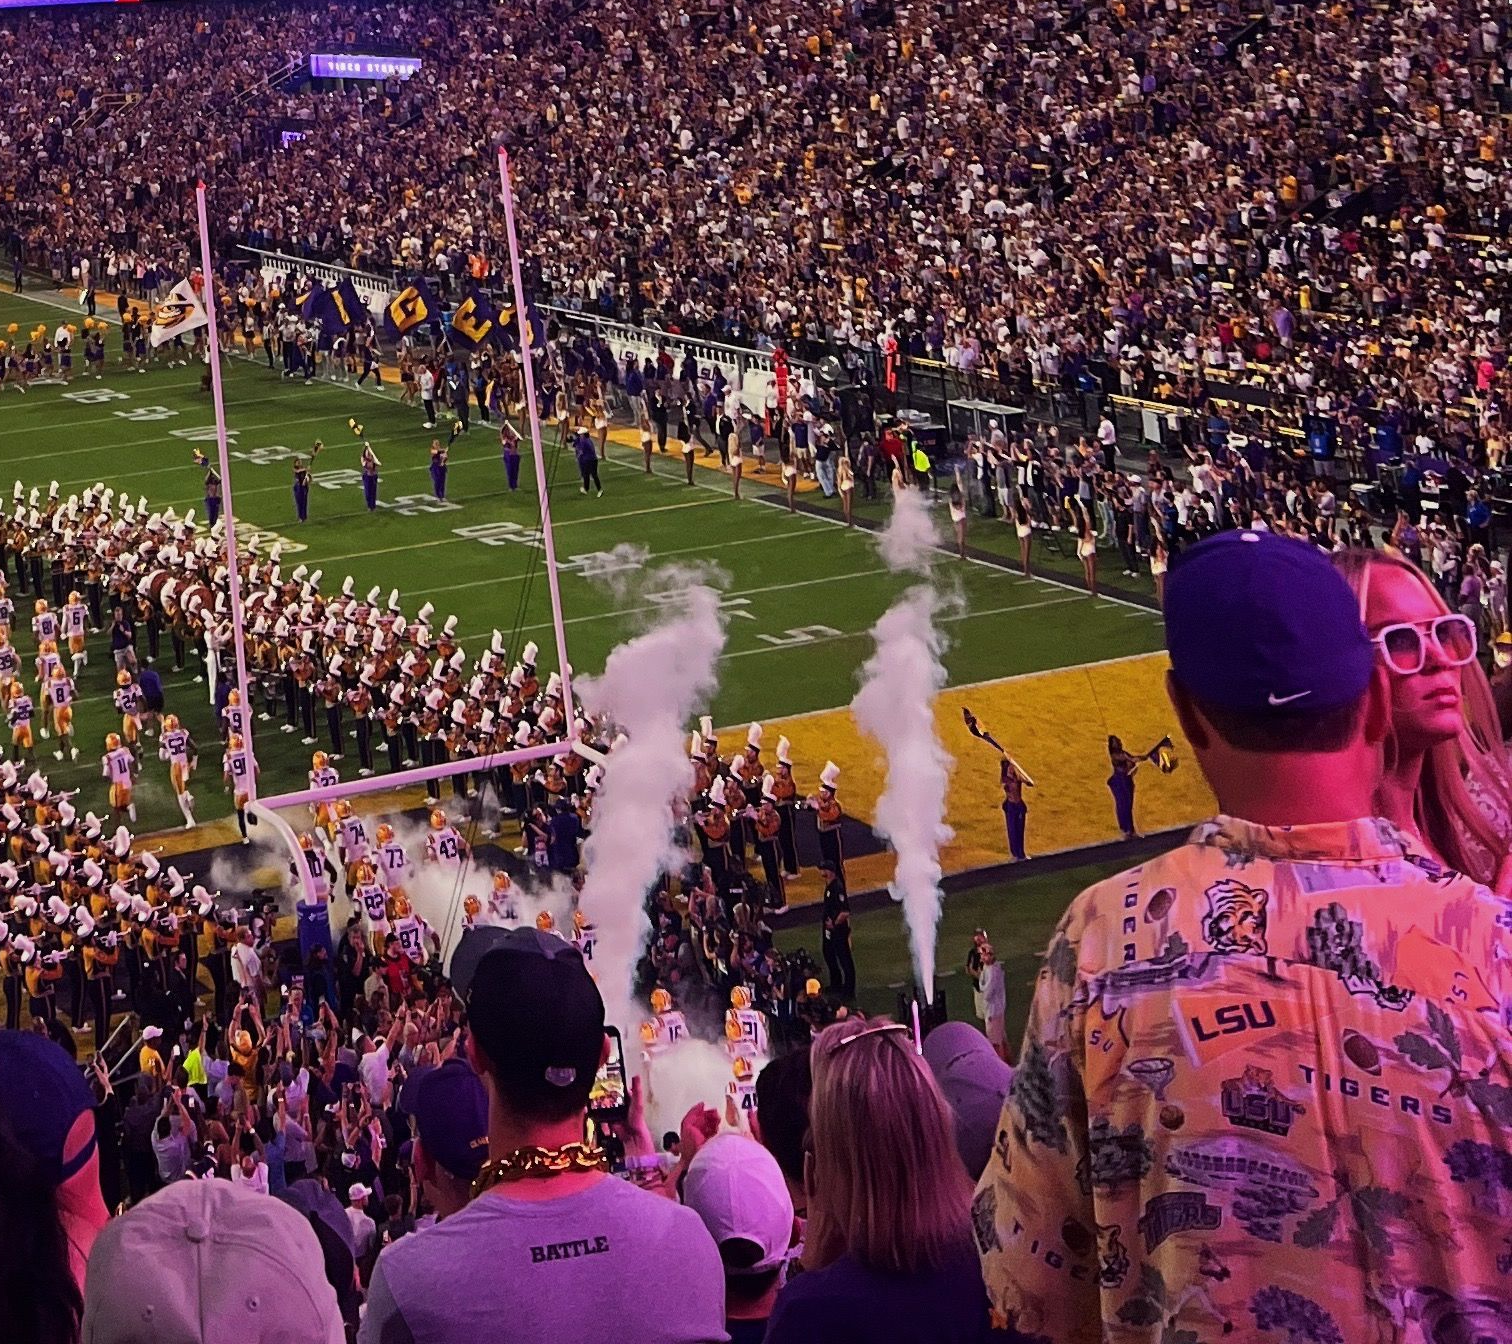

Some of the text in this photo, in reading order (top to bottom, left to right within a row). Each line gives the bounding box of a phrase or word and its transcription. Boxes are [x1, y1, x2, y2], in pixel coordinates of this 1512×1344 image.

[390, 285, 428, 333] G
[450, 295, 492, 344] E
[42, 620, 53, 635] 81
[73, 612, 81, 626] 6
[56, 687, 65, 704] 8
[122, 691, 138, 710] 24
[168, 736, 186, 756] 52
[117, 758, 128, 775] 11
[232, 757, 247, 776] 91
[350, 824, 367, 846] 74
[385, 848, 404, 869] 73
[440, 837, 457, 860] 43
[399, 927, 421, 952] 87
[1191, 1000, 1277, 1043] LSU
[1298, 1064, 1453, 1126] TIGERS
[1221, 1091, 1294, 1128] LSU
[530, 1235, 610, 1264] BATTLE
